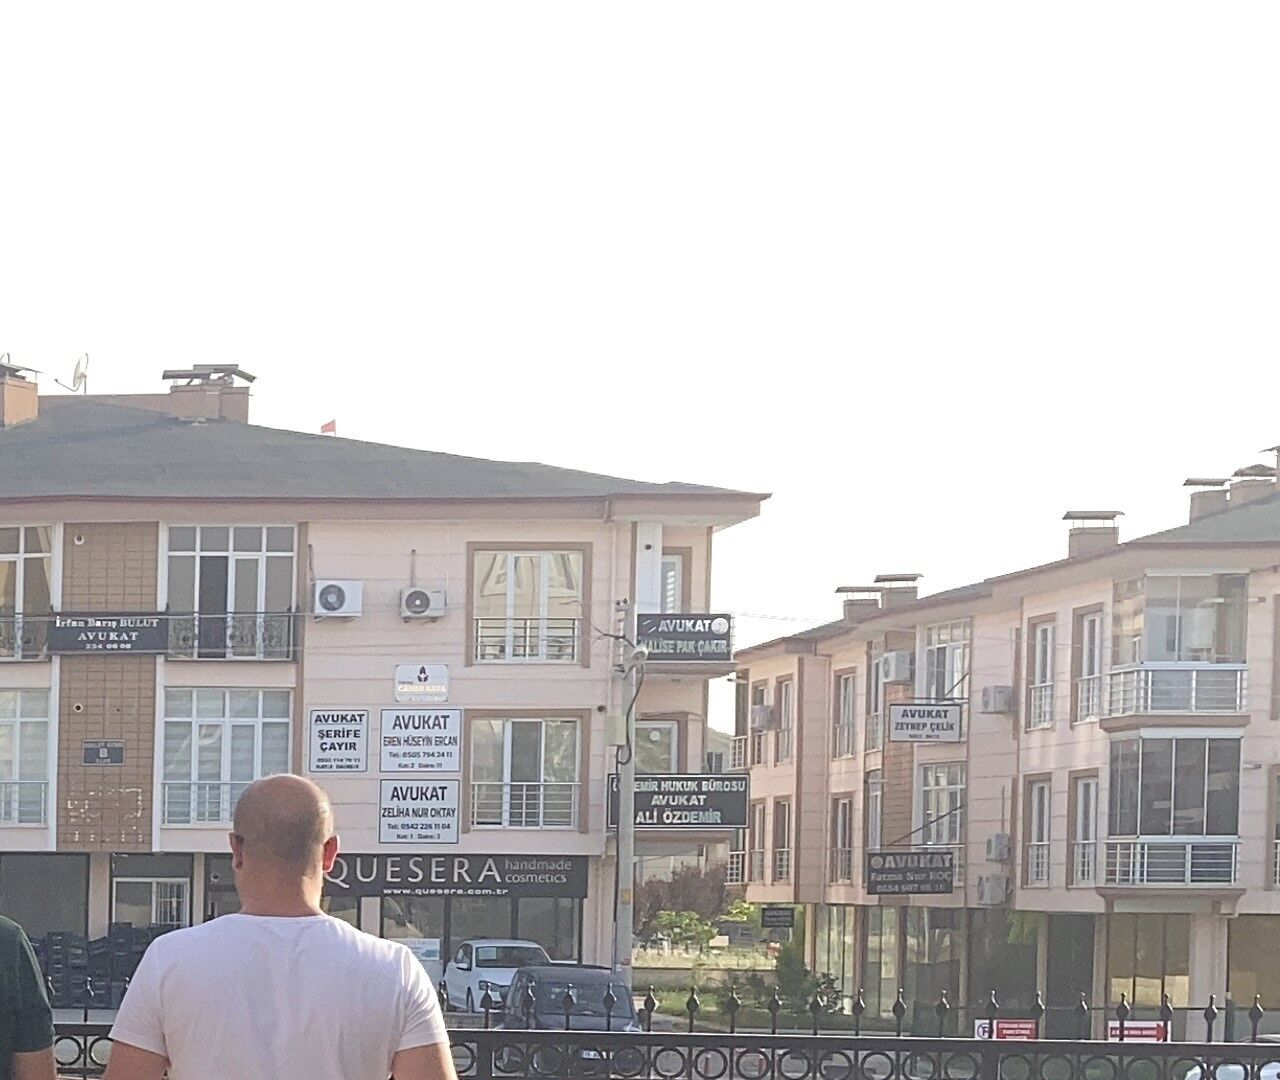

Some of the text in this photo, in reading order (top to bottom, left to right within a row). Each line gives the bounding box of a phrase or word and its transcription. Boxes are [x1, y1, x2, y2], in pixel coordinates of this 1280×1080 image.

[119, 618, 160, 628] BULUT
[658, 619, 712, 632] AVUKAT
[77, 631, 139, 641] AVUKAT
[314, 713, 365, 723] AVUKAT
[901, 709, 950, 719] AVUKAT
[392, 714, 450, 730] AVUKAT
[317, 727, 361, 740] ŞERİFE
[320, 741, 357, 753] ÇAYIR
[660, 780, 699, 792] HUKUK
[391, 786, 448, 801] AVUKAT
[650, 794, 707, 806] AVUKAT
[382, 804, 457, 818] ZELİHA NUR OKTAY
[635, 807, 722, 824] ALİ ÖZDEMİR
[883, 854, 952, 869] AVUKAT
[325, 856, 572, 889] QUESERA handmade
[505, 871, 567, 884] cosmetics
[383, 887, 509, 895] www.quesera.com.tr
